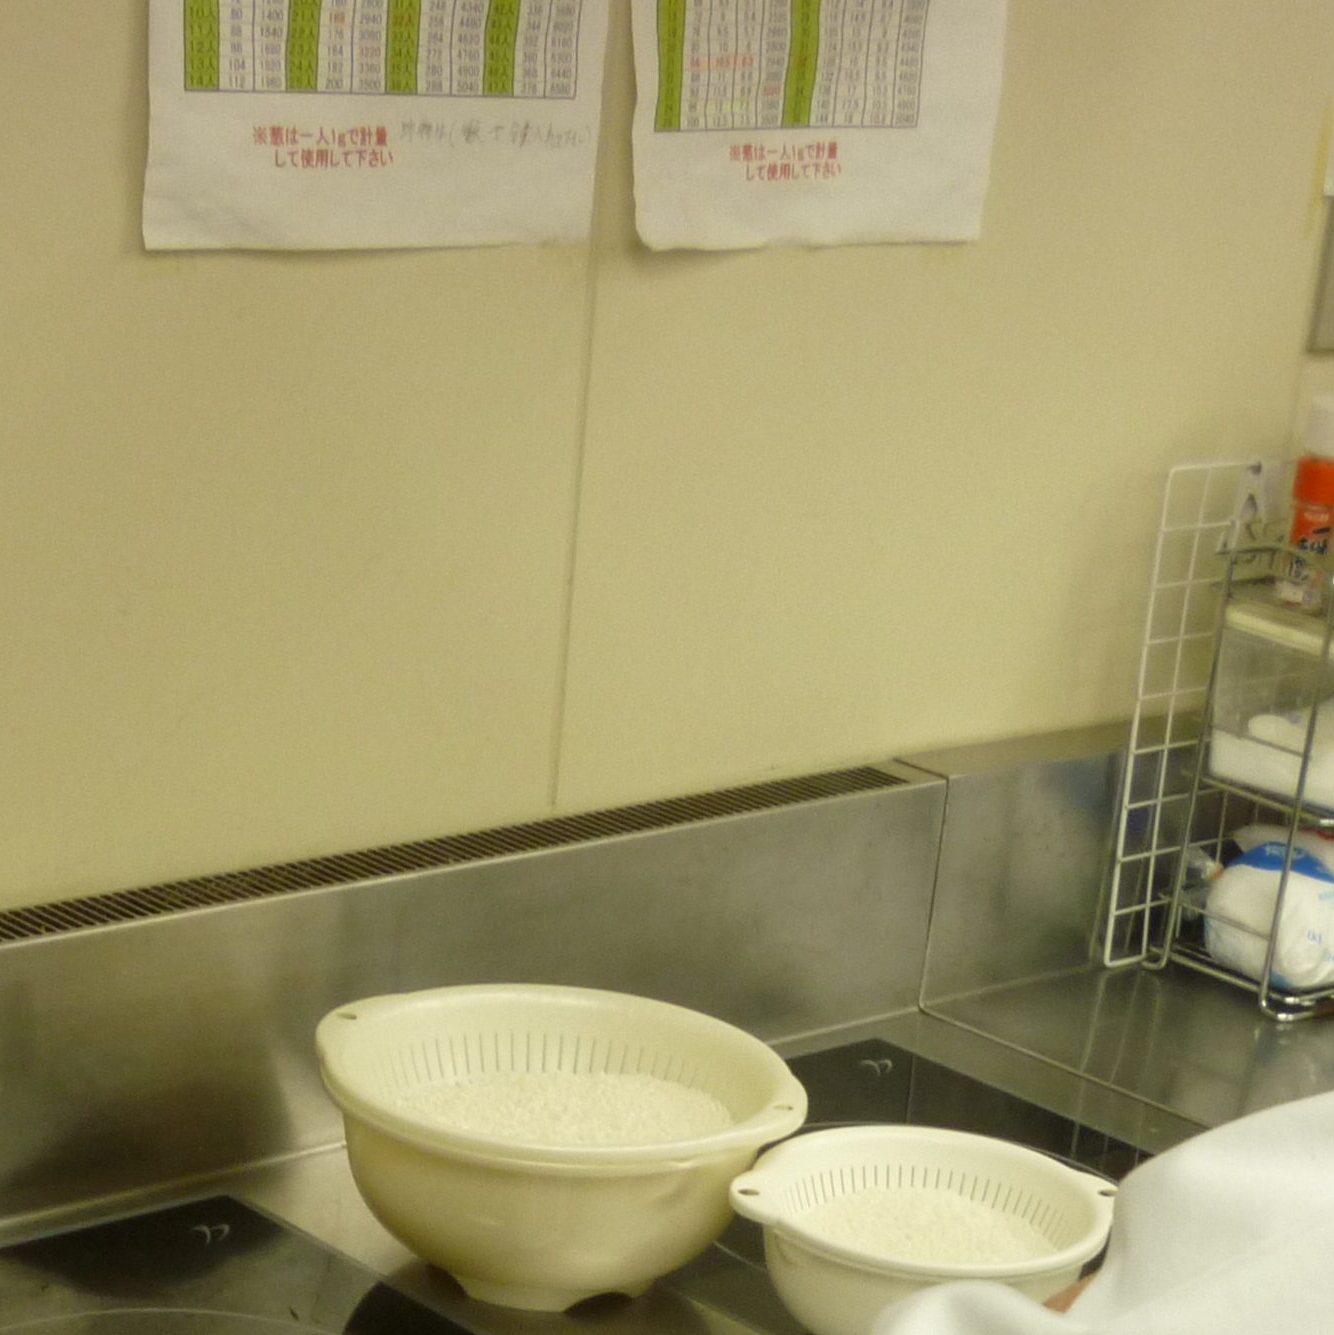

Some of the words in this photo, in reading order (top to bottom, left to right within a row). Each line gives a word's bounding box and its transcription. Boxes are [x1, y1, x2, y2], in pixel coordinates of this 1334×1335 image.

[274, 149, 394, 168] して使用して下さい
[746, 161, 842, 181] して使用して下さい
